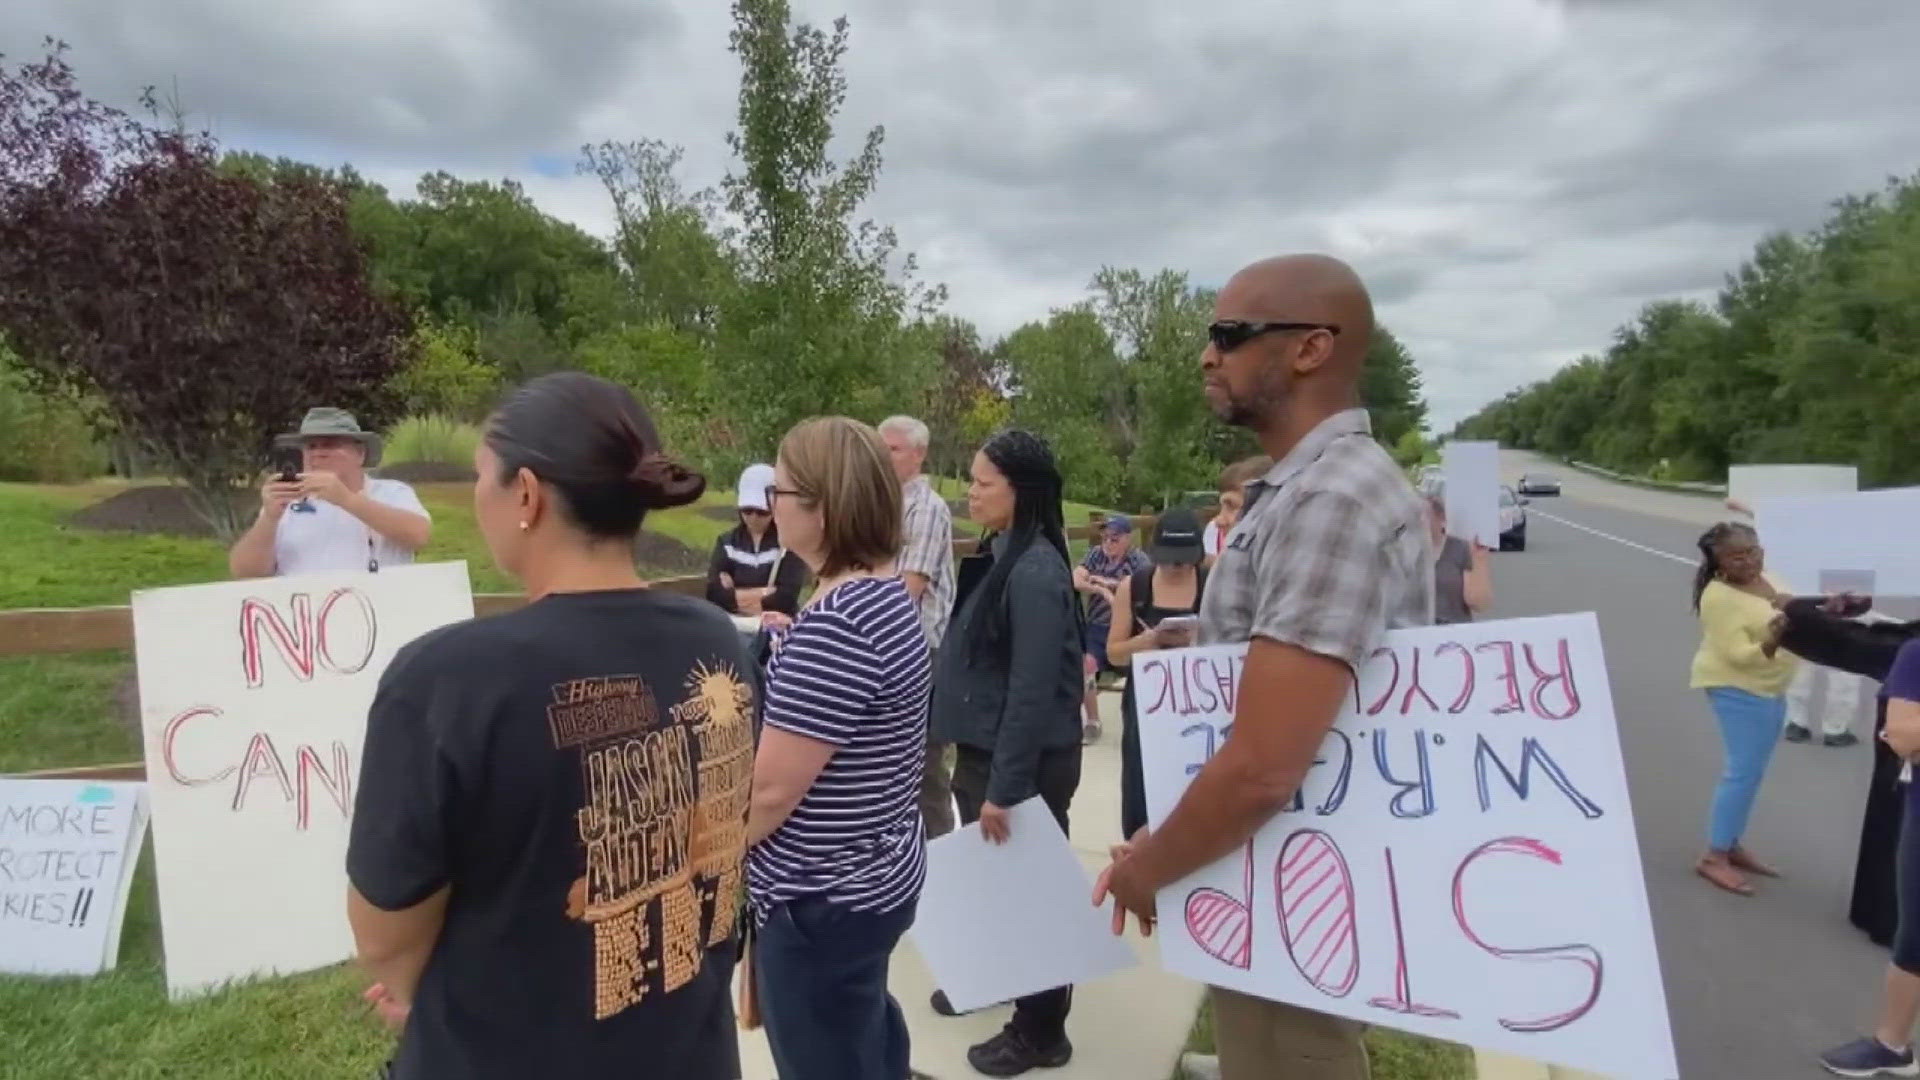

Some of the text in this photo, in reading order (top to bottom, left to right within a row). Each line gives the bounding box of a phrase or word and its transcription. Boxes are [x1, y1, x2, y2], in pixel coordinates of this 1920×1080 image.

[240, 587, 377, 688] NO
[1, 804, 116, 835] MORE
[163, 704, 351, 831] CAN
[579, 725, 695, 842] JASON
[1185, 827, 1604, 1032] STOP
